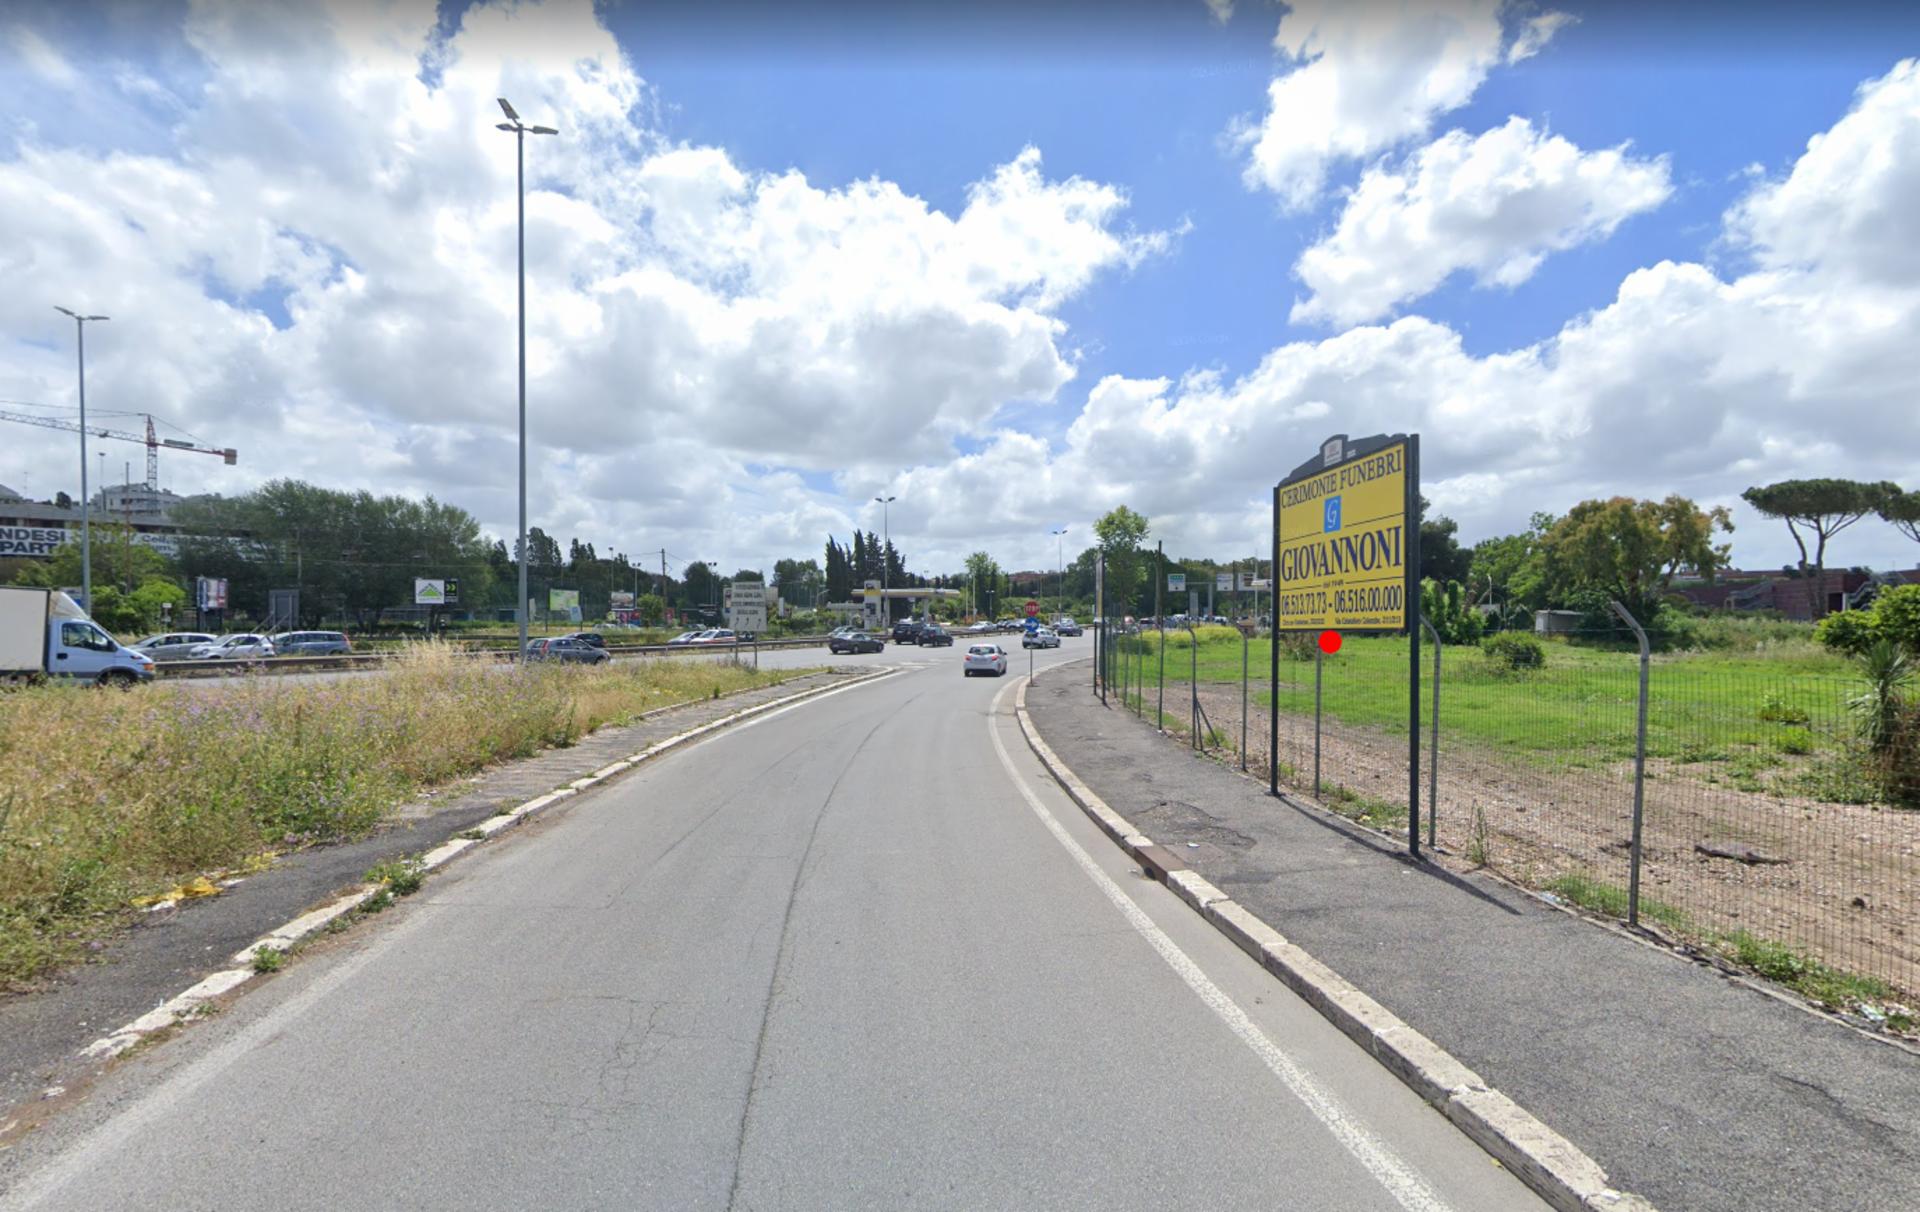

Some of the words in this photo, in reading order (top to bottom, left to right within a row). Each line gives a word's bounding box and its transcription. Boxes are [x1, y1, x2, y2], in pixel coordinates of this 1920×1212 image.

[1281, 473, 1337, 509] CERIMONIE
[1340, 449, 1402, 490] FUNEBRI
[0, 527, 65, 542] NDESI
[1281, 525, 1402, 582] GIOVANNONI
[1334, 584, 1402, 614] 06.516.00.000
